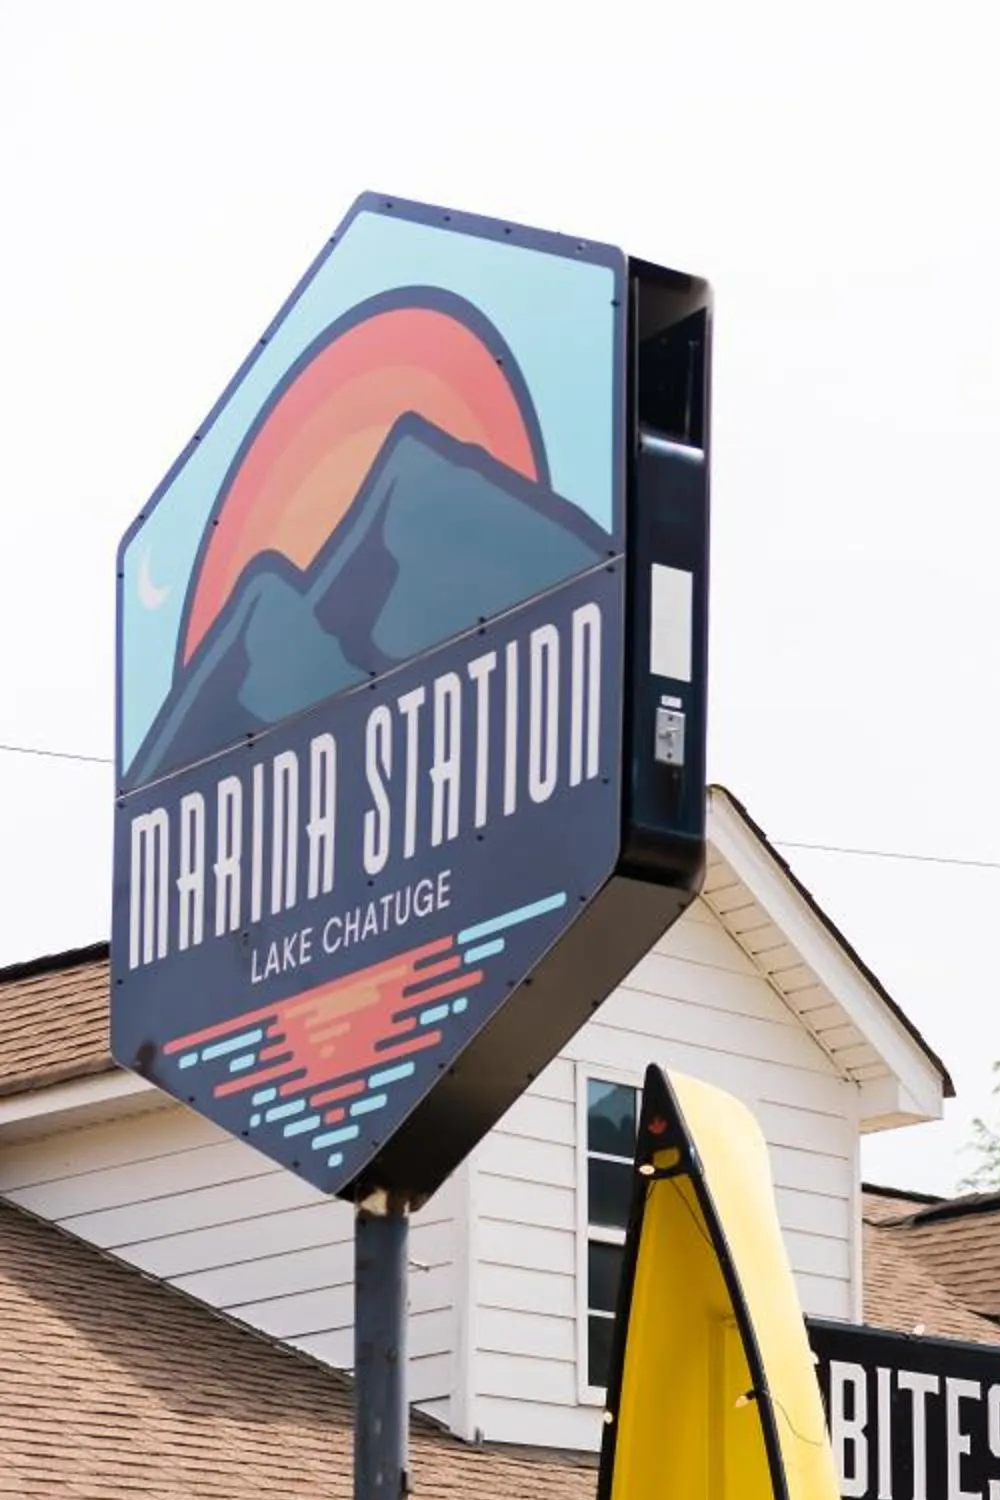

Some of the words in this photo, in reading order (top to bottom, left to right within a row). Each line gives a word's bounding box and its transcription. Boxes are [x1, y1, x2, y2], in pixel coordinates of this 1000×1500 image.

[129, 733, 337, 969] MARINA
[363, 601, 601, 875] STATION
[251, 932, 313, 983] LAKE
[322, 869, 452, 954] CHATUGE
